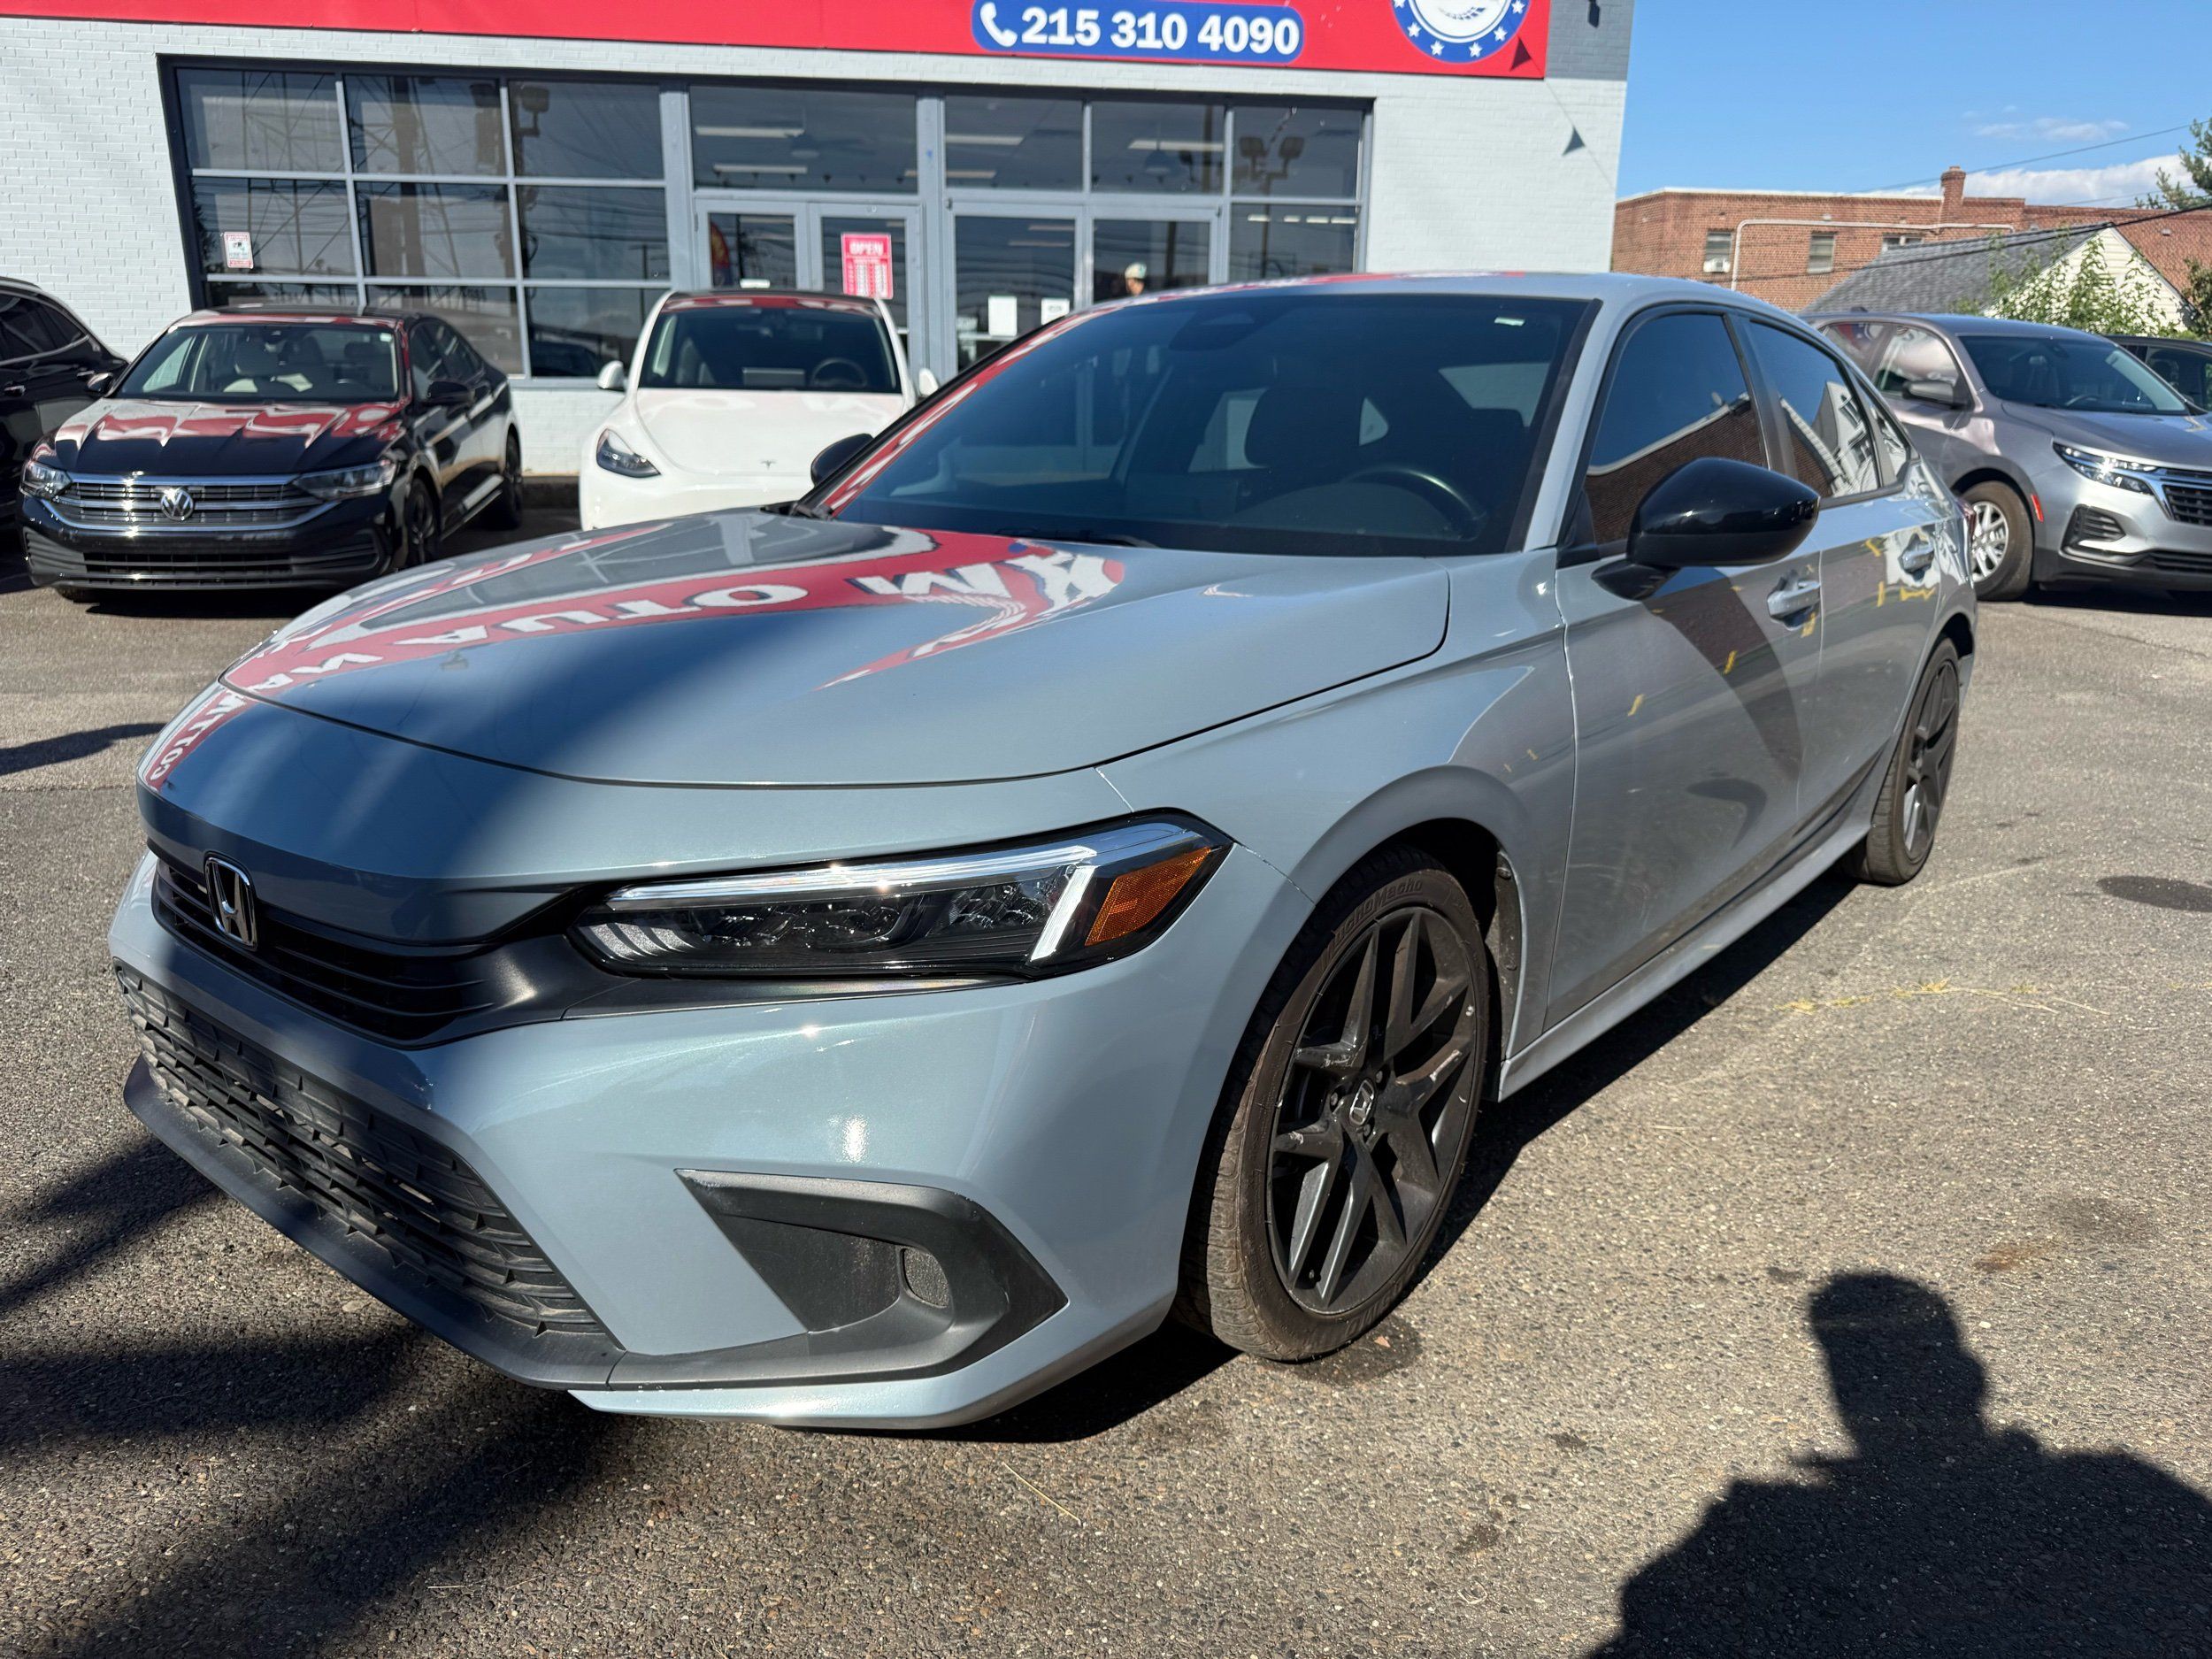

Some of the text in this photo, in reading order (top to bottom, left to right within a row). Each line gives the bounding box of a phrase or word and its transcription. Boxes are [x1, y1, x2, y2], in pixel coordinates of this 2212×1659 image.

[1021, 6, 1301, 55] 215 310 4090
[849, 241, 884, 256] OPEN
